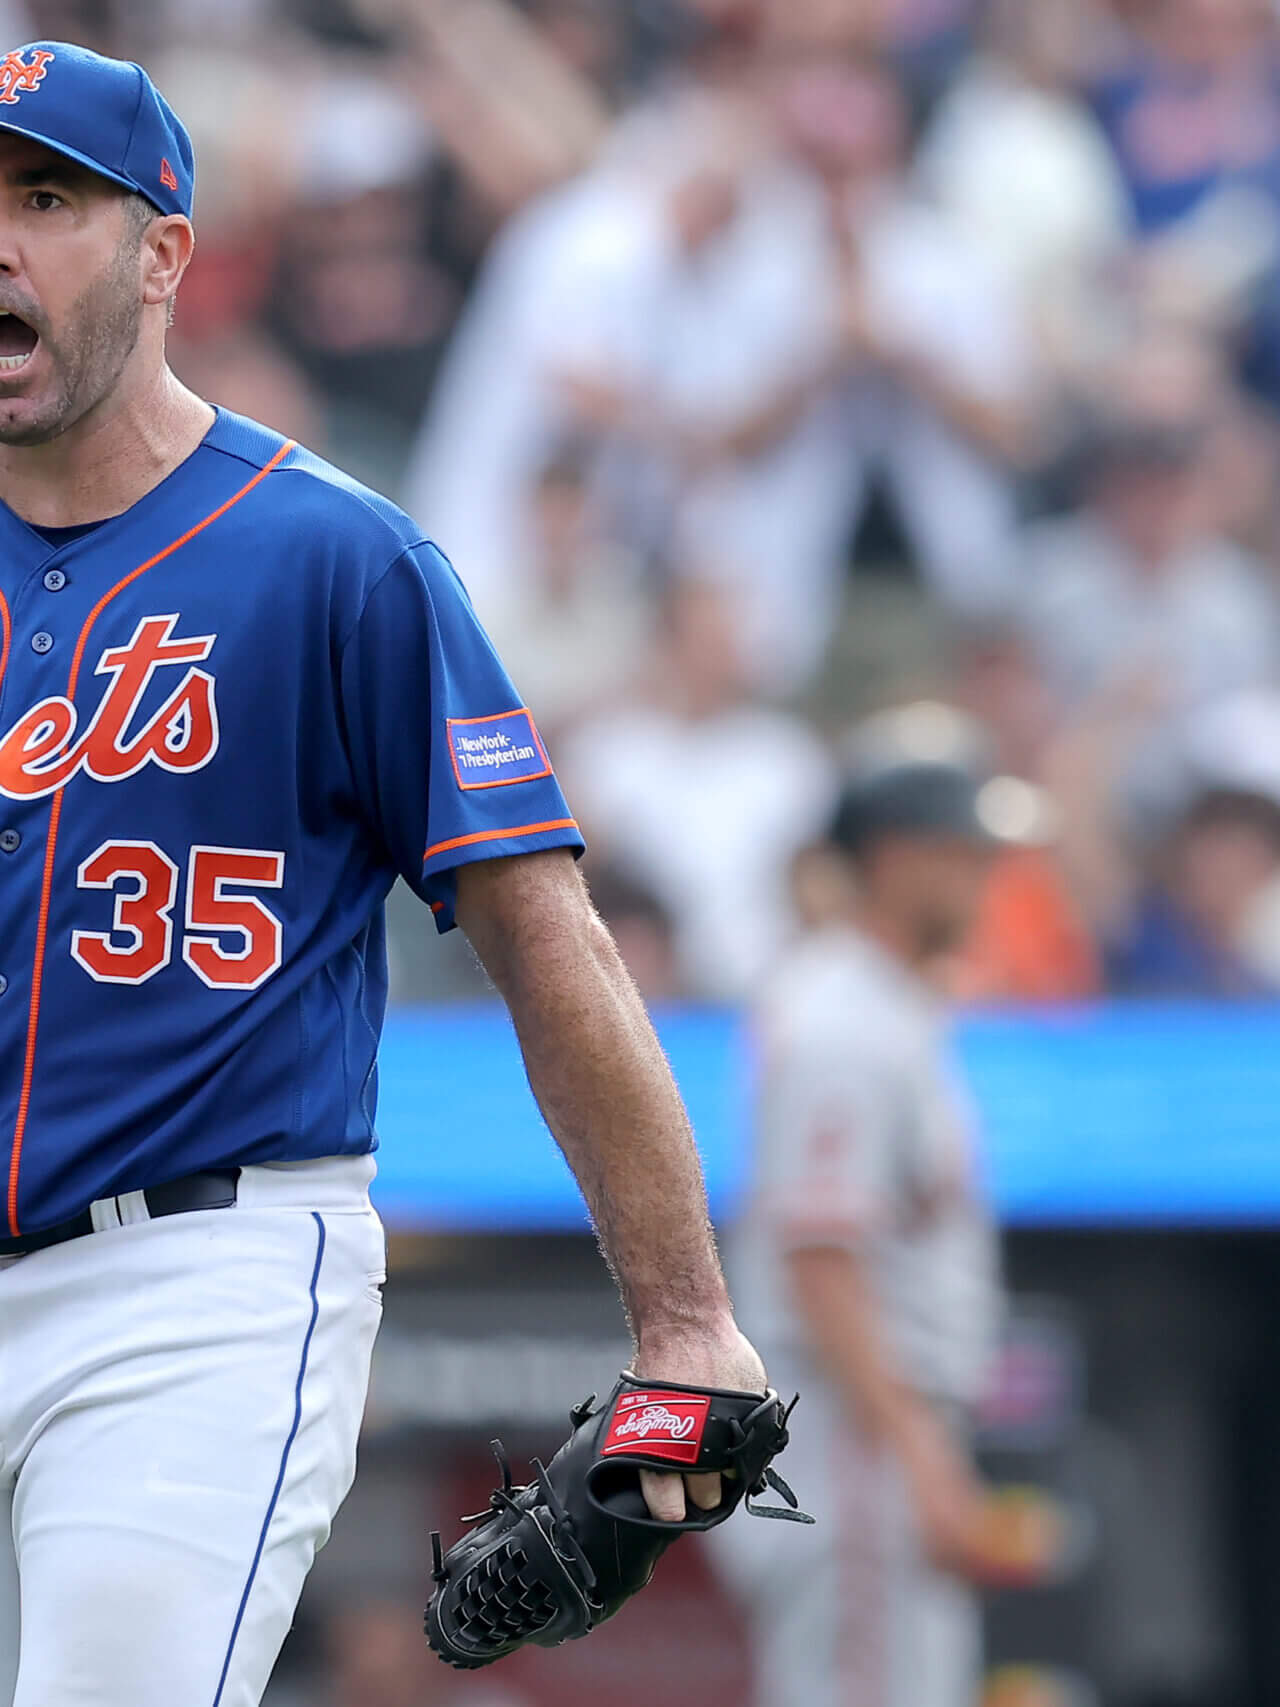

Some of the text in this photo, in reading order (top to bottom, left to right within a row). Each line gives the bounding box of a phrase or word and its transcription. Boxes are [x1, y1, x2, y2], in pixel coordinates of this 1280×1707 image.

[466, 745, 535, 768] Presbyterian
[70, 839, 286, 990] 35
[615, 1411, 695, 1438] Rawlings
